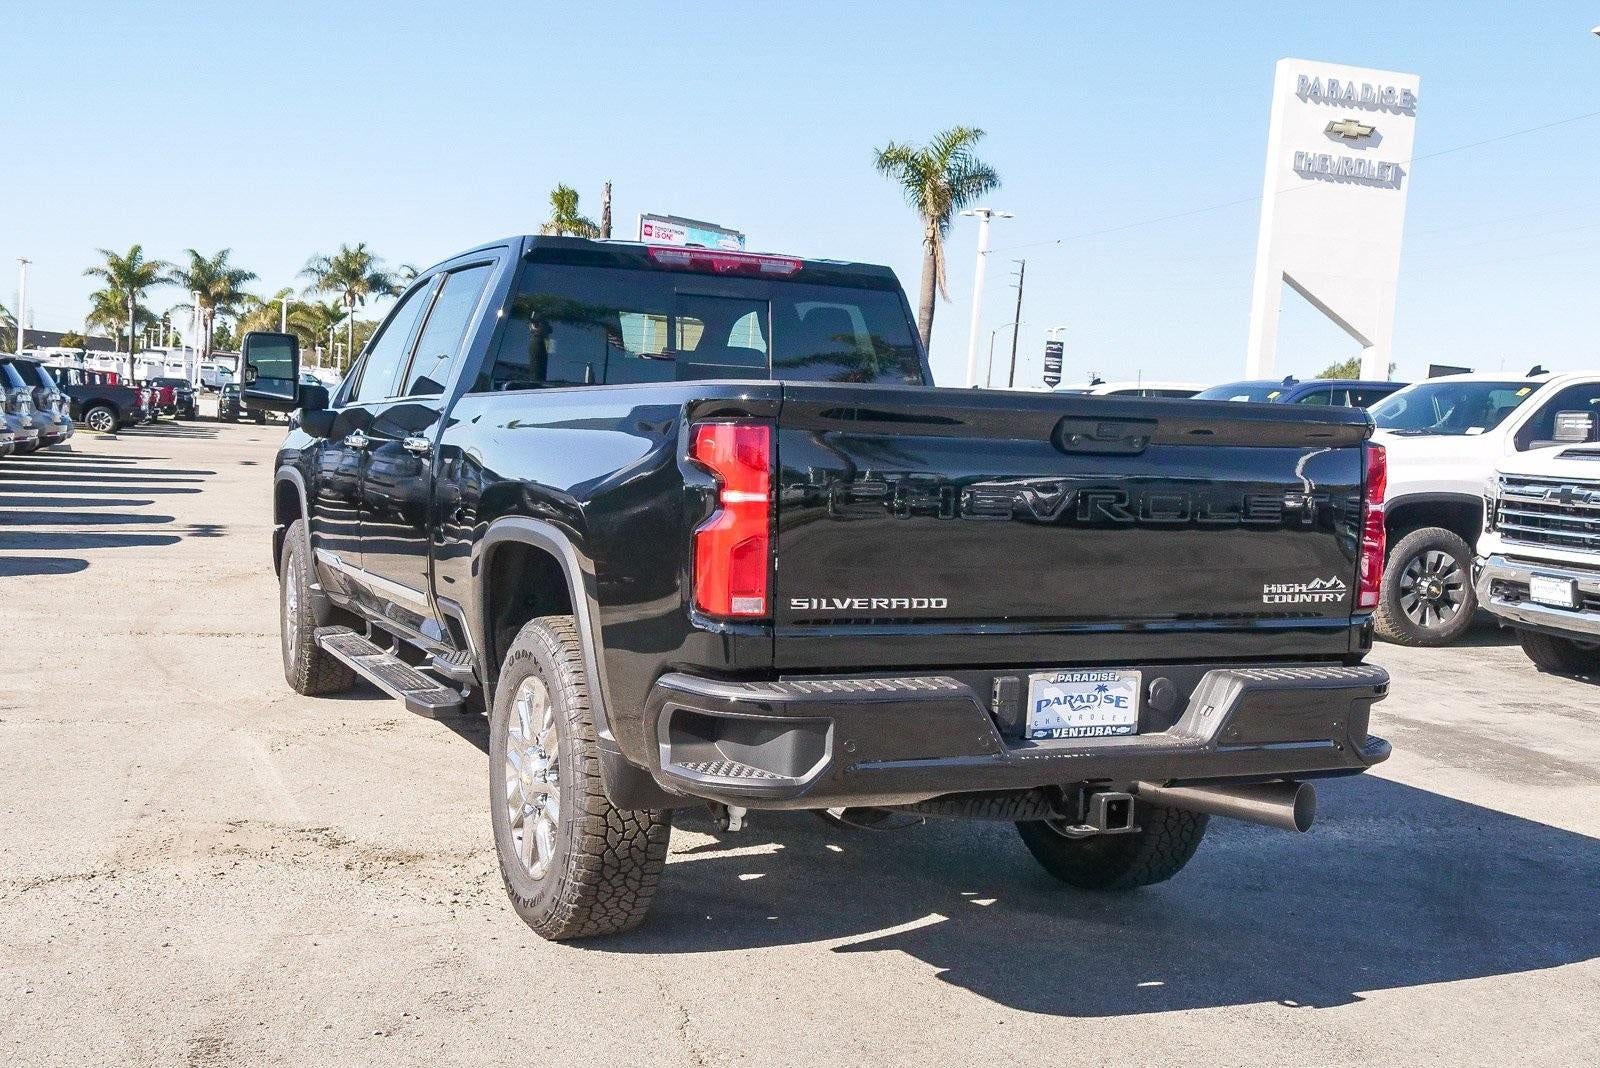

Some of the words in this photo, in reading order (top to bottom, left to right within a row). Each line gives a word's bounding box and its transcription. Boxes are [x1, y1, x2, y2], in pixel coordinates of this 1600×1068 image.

[1297, 74, 1414, 108] PARADISE
[1294, 151, 1402, 182] CHEVROLET
[829, 483, 1330, 524] CHEVROLET
[1263, 583, 1307, 593] HIGH
[790, 597, 948, 610] SILVERADO
[1262, 593, 1346, 604] COUNTRY
[1057, 672, 1116, 682] PARADISE
[1036, 688, 1129, 713] PARADISE
[1034, 714, 1128, 726] CHEVROLET
[1052, 726, 1114, 738] VENTURA
